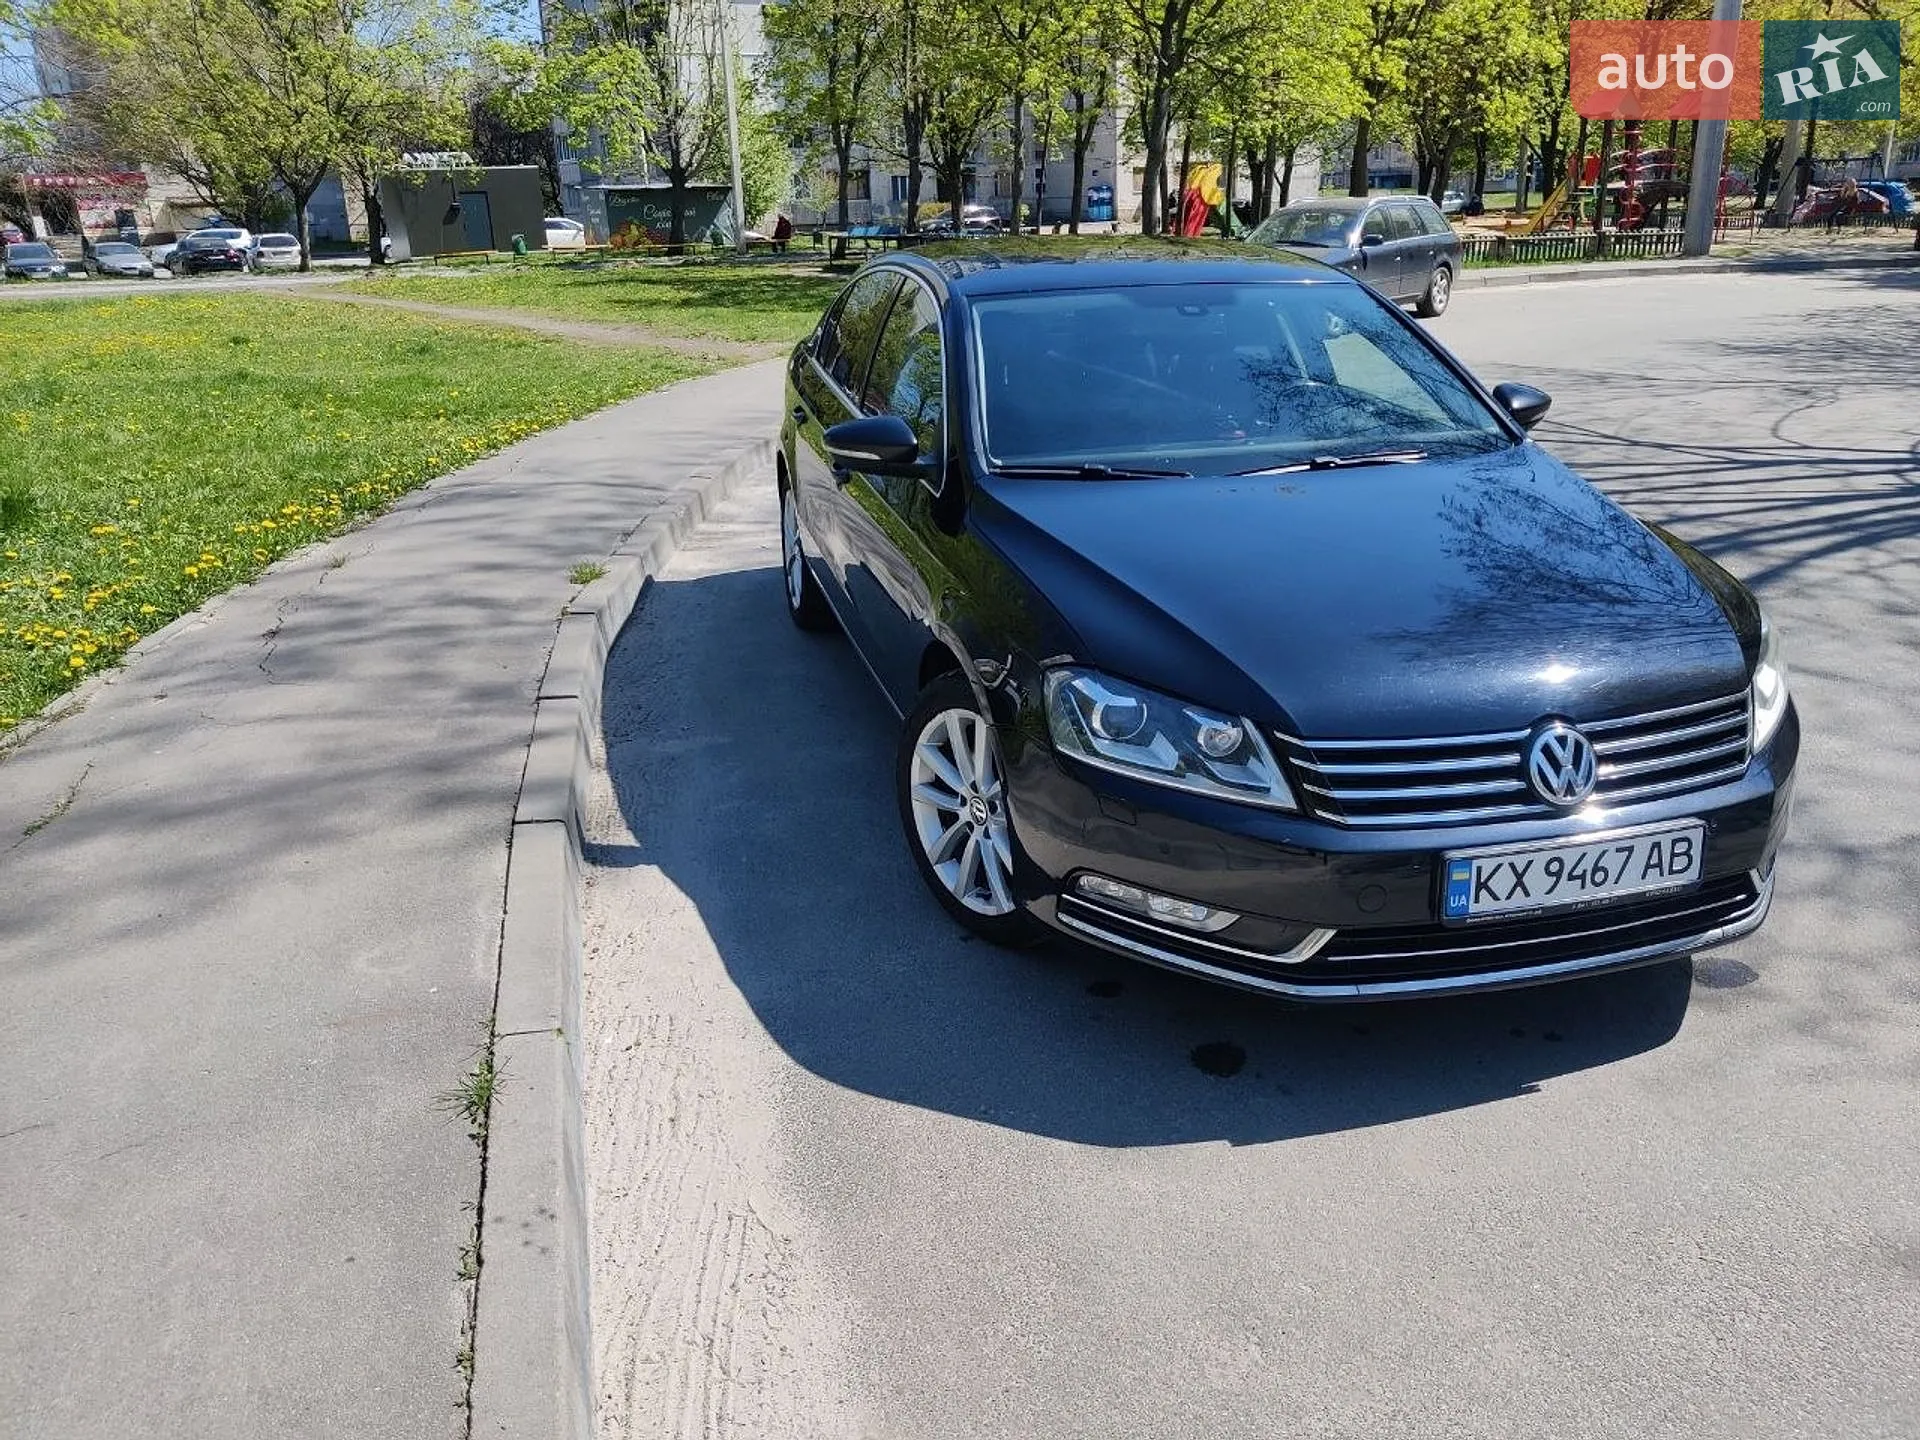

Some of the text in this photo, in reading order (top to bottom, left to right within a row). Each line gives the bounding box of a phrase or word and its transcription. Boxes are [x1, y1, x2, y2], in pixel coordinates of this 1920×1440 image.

[1473, 836, 1694, 904] KX 9467 AB
[1450, 895, 1467, 908] UA
